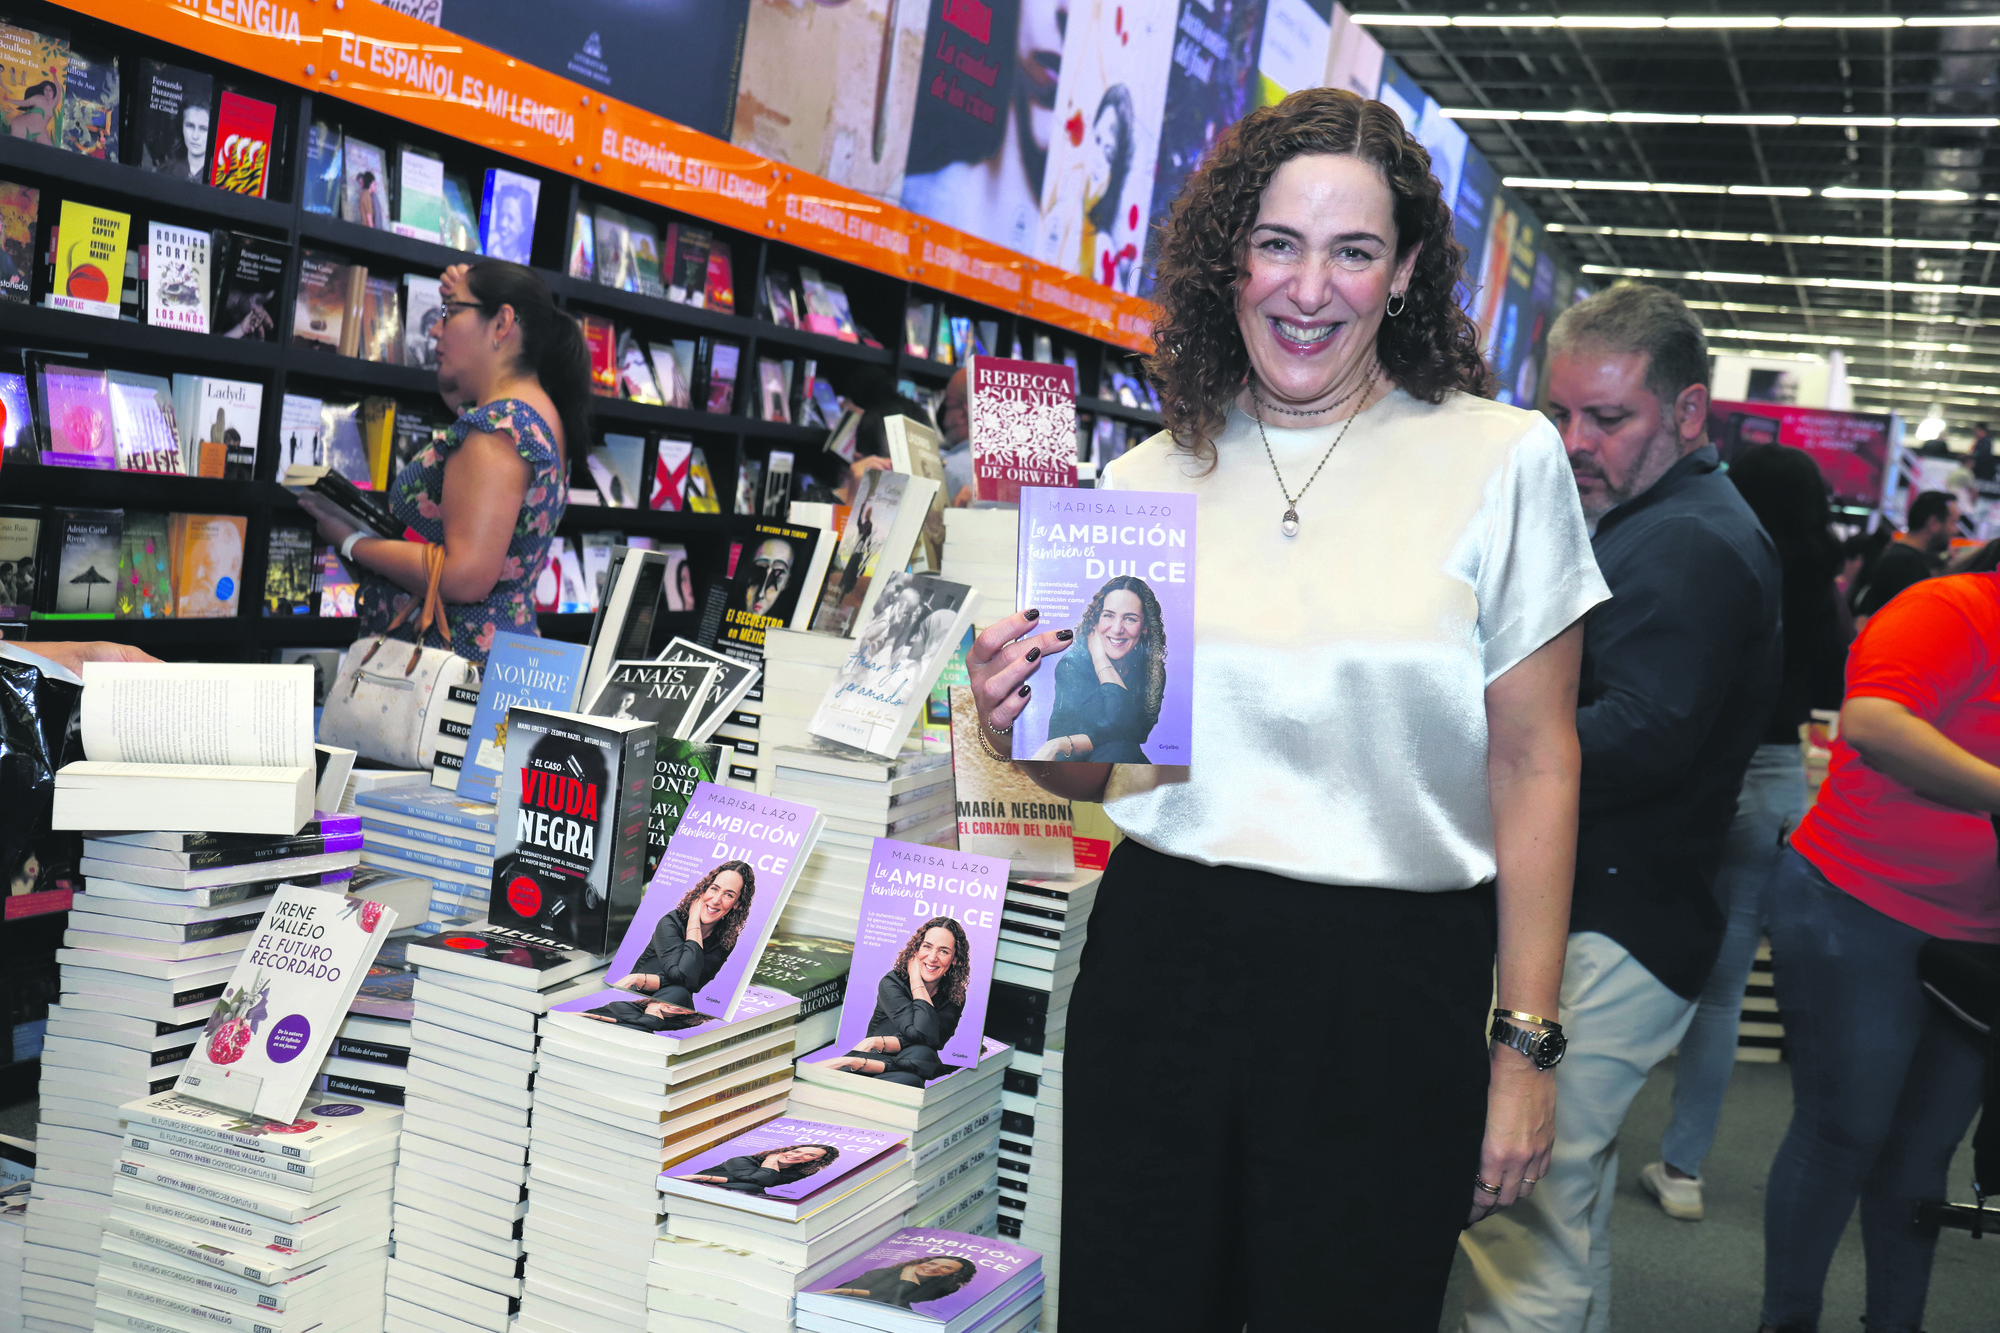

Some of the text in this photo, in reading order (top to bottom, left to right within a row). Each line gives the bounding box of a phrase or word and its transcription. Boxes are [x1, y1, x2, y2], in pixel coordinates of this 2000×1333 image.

[204, 0, 302, 46] LENGUA
[152, 76, 183, 91] Fernando
[340, 30, 576, 143] EL ESPAÑOL ES MI LENGUA
[601, 128, 768, 209] EL ESPAÑOL ES MI LENGUA
[92, 216, 121, 230] GIUSEPPE
[785, 193, 800, 218] EL
[801, 196, 846, 235] ESPAÑOL
[846, 215, 860, 238] ES
[91, 226, 115, 239] CAPUTO
[156, 229, 205, 250] RODRIGO
[89, 240, 116, 253] ESTRELLA
[89, 250, 110, 261] MADRE
[156, 244, 205, 265] CORTÉS
[53, 296, 69, 307] MAPA
[75, 300, 85, 310] LAS
[155, 308, 204, 326] LOS AÑOS
[978, 368, 1071, 394] REBECCA
[207, 383, 246, 404] Ladydi
[990, 386, 1061, 407] SOLNIT
[984, 449, 1070, 474] LAS ROSAS
[981, 465, 1074, 488] DE ORWELL
[1049, 501, 1172, 517] MARISA LAZO
[66, 533, 86, 543] Rivera
[67, 524, 88, 534] Adrián
[755, 524, 762, 532] EL
[1030, 518, 1186, 548] La AMBICIÓN
[1027, 541, 1096, 560] también es
[1085, 558, 1186, 583] DULCE
[725, 608, 784, 629] El SECUESTRO
[727, 628, 738, 639] en
[613, 666, 688, 684] ANAÏS
[845, 645, 902, 688] Amor y
[490, 662, 571, 694] NOMBRE
[520, 687, 530, 696] es
[646, 684, 695, 701] NIN
[857, 677, 909, 708] amado
[517, 722, 531, 732] MANU
[531, 725, 548, 734] URESTE
[550, 728, 567, 739] ZEDRYK
[567, 732, 581, 742] RAZIEL
[583, 736, 600, 747] ARTURO
[1158, 743, 1180, 751] Grijalbo
[441, 755, 463, 768] ERRO
[534, 758, 562, 772] EL CASO
[520, 767, 598, 821] VIUDA
[415, 808, 438, 820] NOMBRE
[444, 813, 463, 825] BRONI
[708, 793, 797, 822] MARISA LAZO
[957, 797, 1072, 821] MARÍA NEGRONI
[515, 808, 595, 861] NEGRA
[678, 823, 729, 842] también es
[686, 804, 801, 848] La AMBICIÓN
[957, 820, 1073, 839] EL CORAZÓN DEL DAÑO
[521, 850, 543, 860] ASESINATO
[542, 854, 551, 862] QUE
[565, 861, 590, 873] DESCUBIERTO
[711, 842, 789, 876] DULCE
[892, 850, 989, 875] MARISA LAZO
[870, 881, 925, 899] también es
[875, 862, 999, 901] La AMBICIÓN
[275, 900, 317, 921] IRENE
[913, 899, 995, 929] DULCE
[269, 916, 325, 940] VALLEJO
[258, 934, 333, 963] EL FUTURO
[249, 950, 341, 982] RECORDADO
[801, 981, 838, 1002] ILDEFONSO
[799, 990, 840, 1016] FALCONES
[341, 1044, 389, 1059] El silbido del arquero
[185, 1076, 201, 1087] DEBATE
[715, 1092, 727, 1102] CON
[726, 1089, 733, 1098] LA
[158, 1118, 180, 1129] FUTURO
[180, 1122, 217, 1137] RECORDADO
[216, 1131, 235, 1142] IRENE
[235, 1135, 260, 1147] VALLEJO
[282, 1146, 300, 1157] DEBATE
[781, 1125, 890, 1147] AMBICIÓN
[943, 1113, 990, 1149] EL REY DEL CASH
[793, 1136, 876, 1154] DULCE
[909, 1235, 1023, 1265] AMBICIÓN
[926, 1247, 1013, 1274] DULCE
